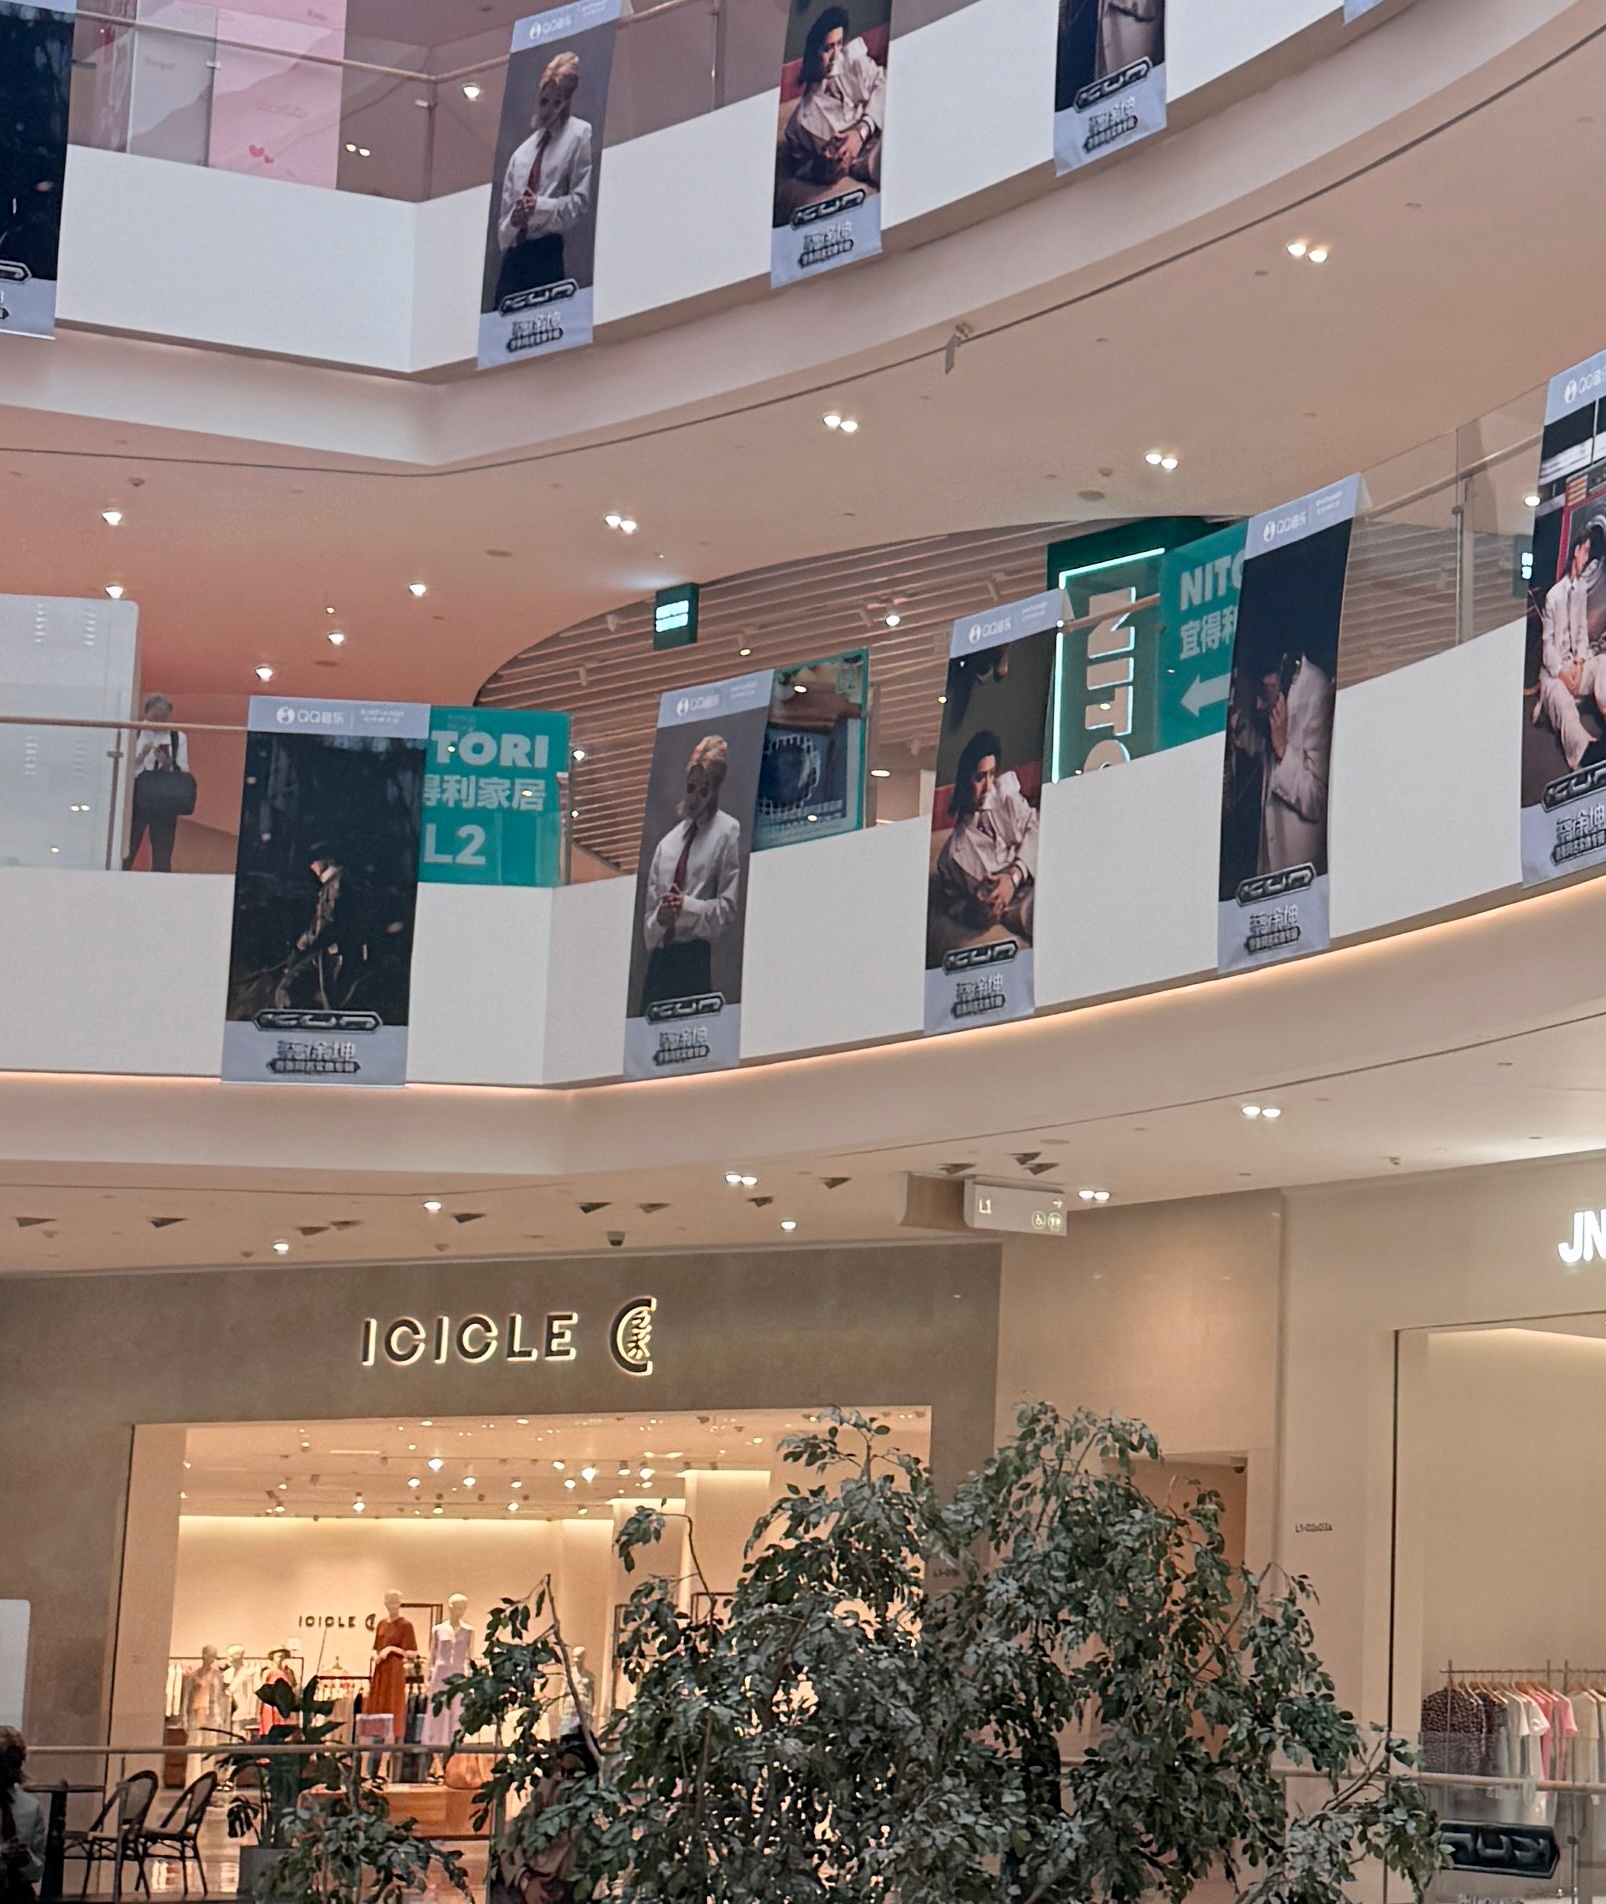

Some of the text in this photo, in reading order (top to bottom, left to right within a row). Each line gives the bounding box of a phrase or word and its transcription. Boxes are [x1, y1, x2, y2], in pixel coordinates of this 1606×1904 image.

[424, 824, 487, 865] L2
[979, 1199, 992, 1214] L1
[361, 1312, 579, 1367] ICICLE
[299, 1615, 356, 1628] ICICLE
